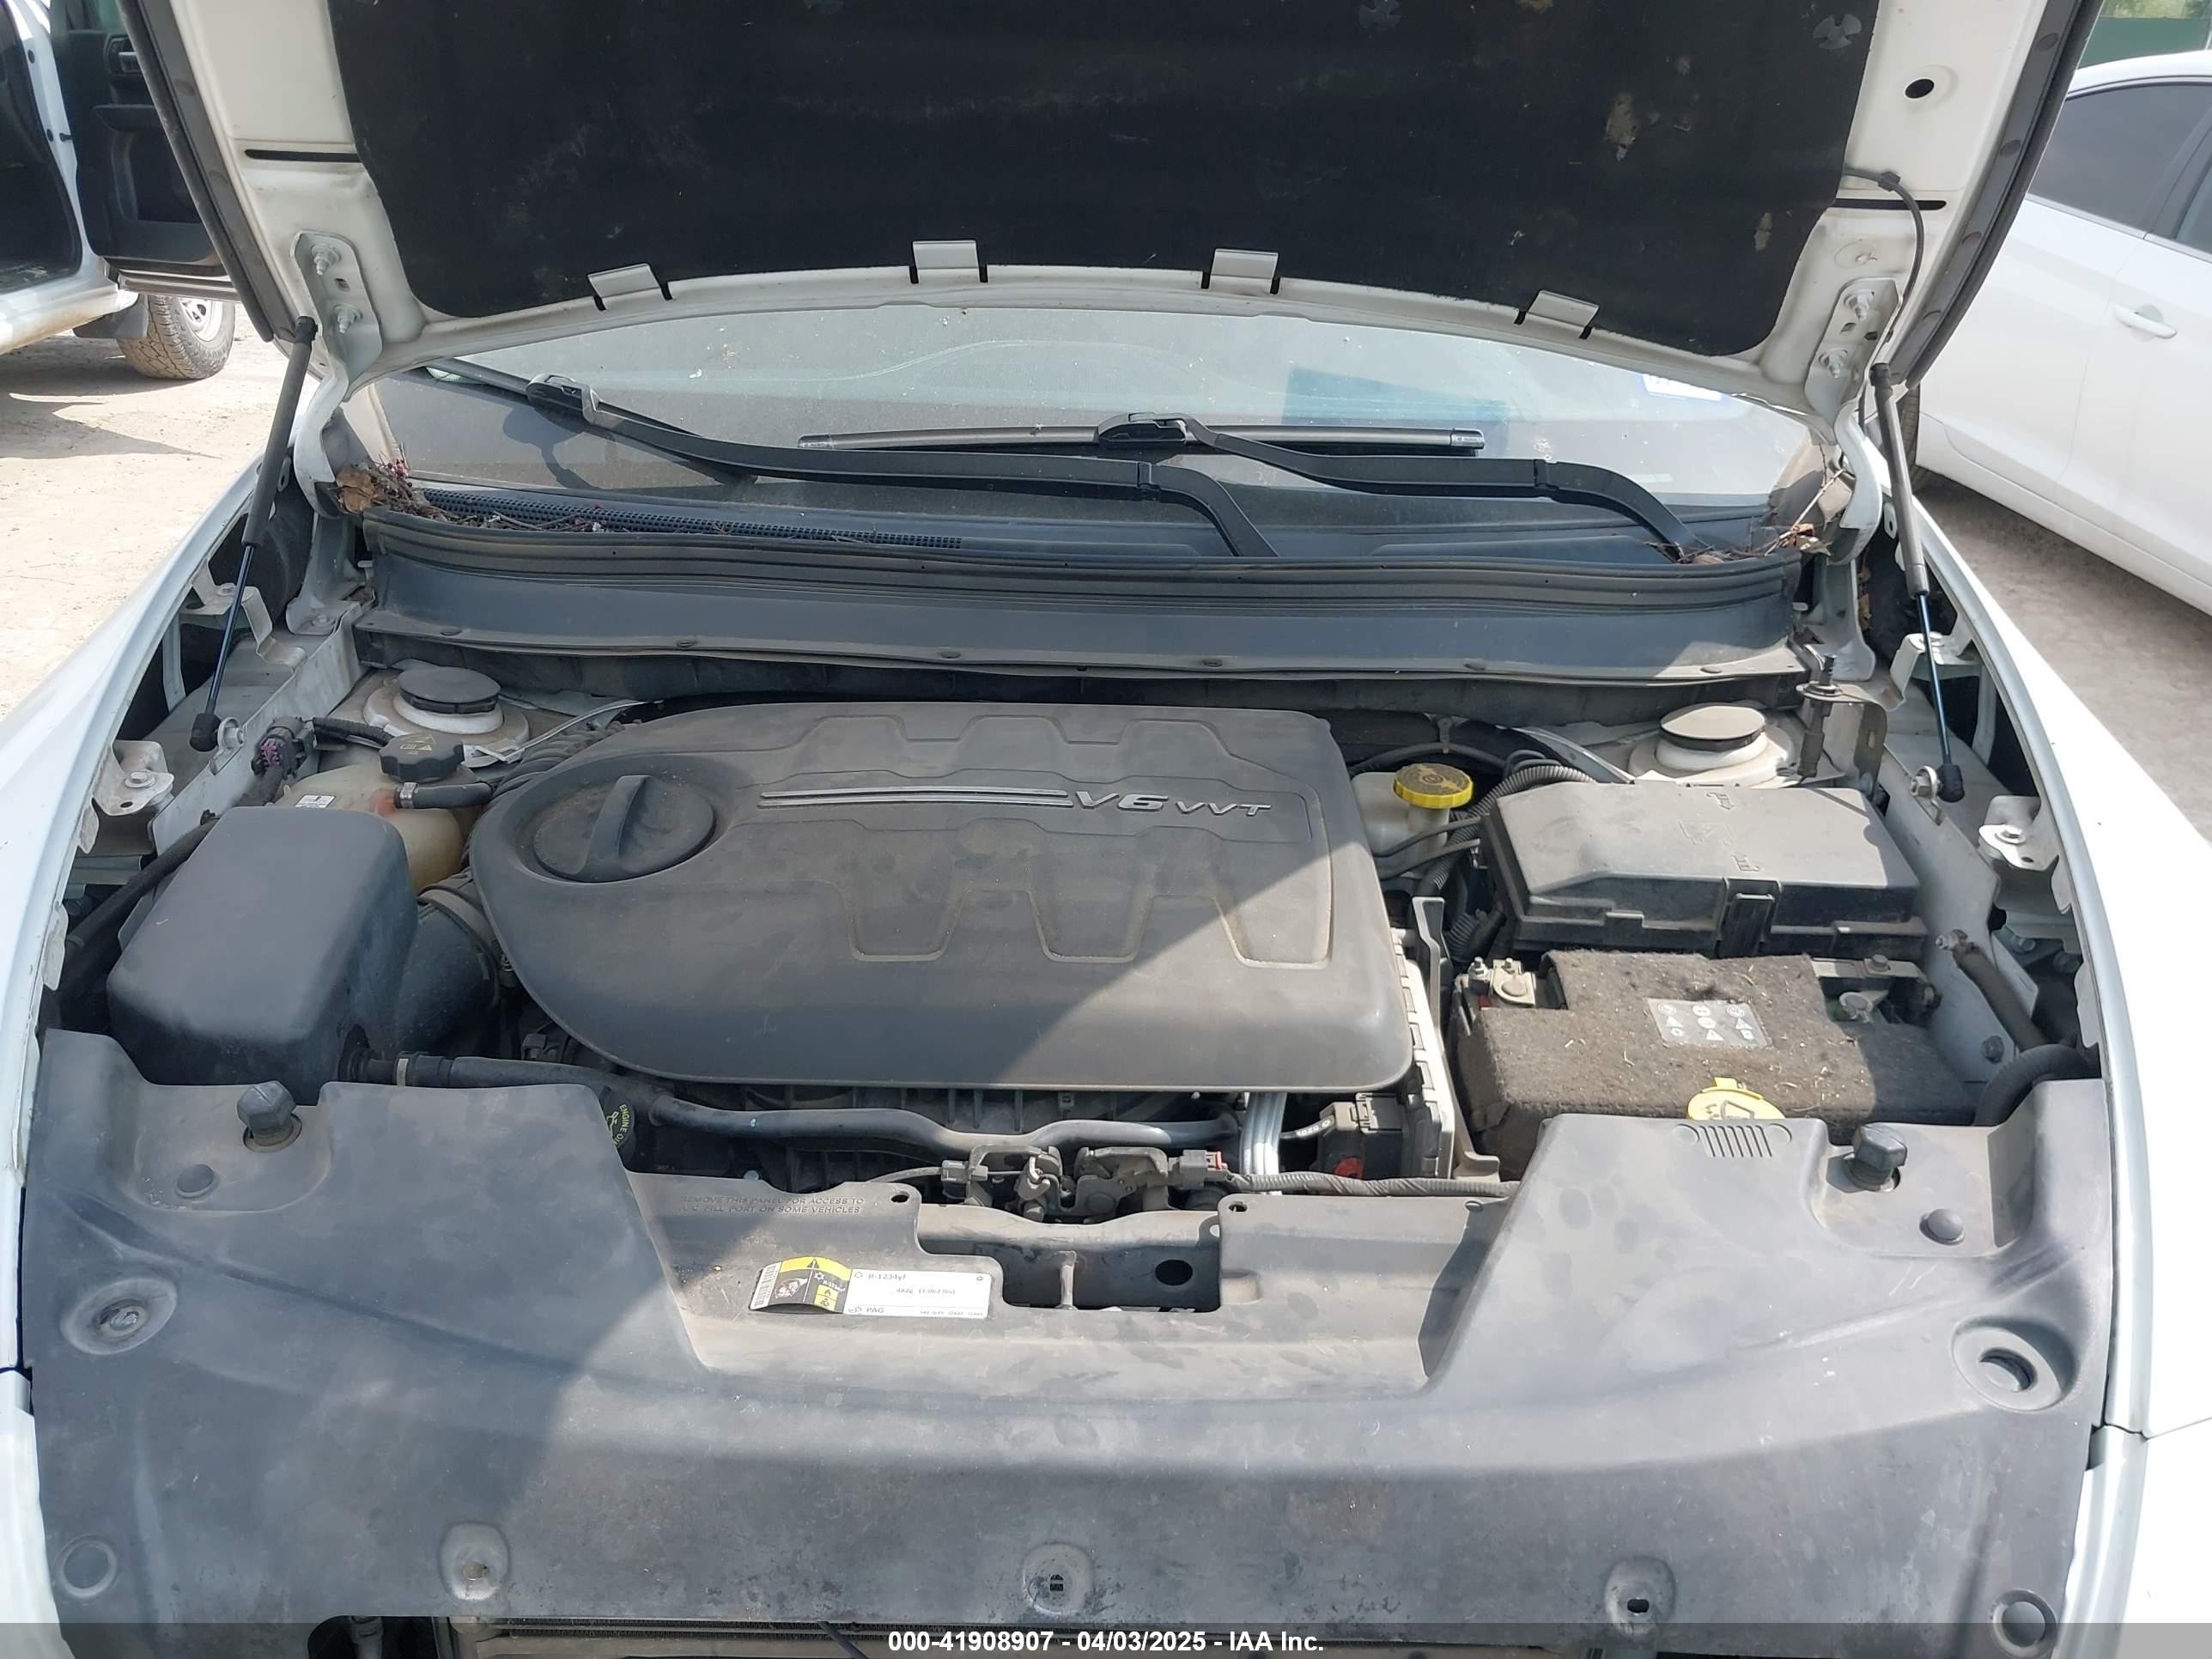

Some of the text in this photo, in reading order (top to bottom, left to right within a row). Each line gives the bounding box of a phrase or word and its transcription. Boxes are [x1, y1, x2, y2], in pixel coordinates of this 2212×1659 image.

[1074, 791, 1272, 817] V6 VVT
[619, 1103, 630, 1133] ENGINE
